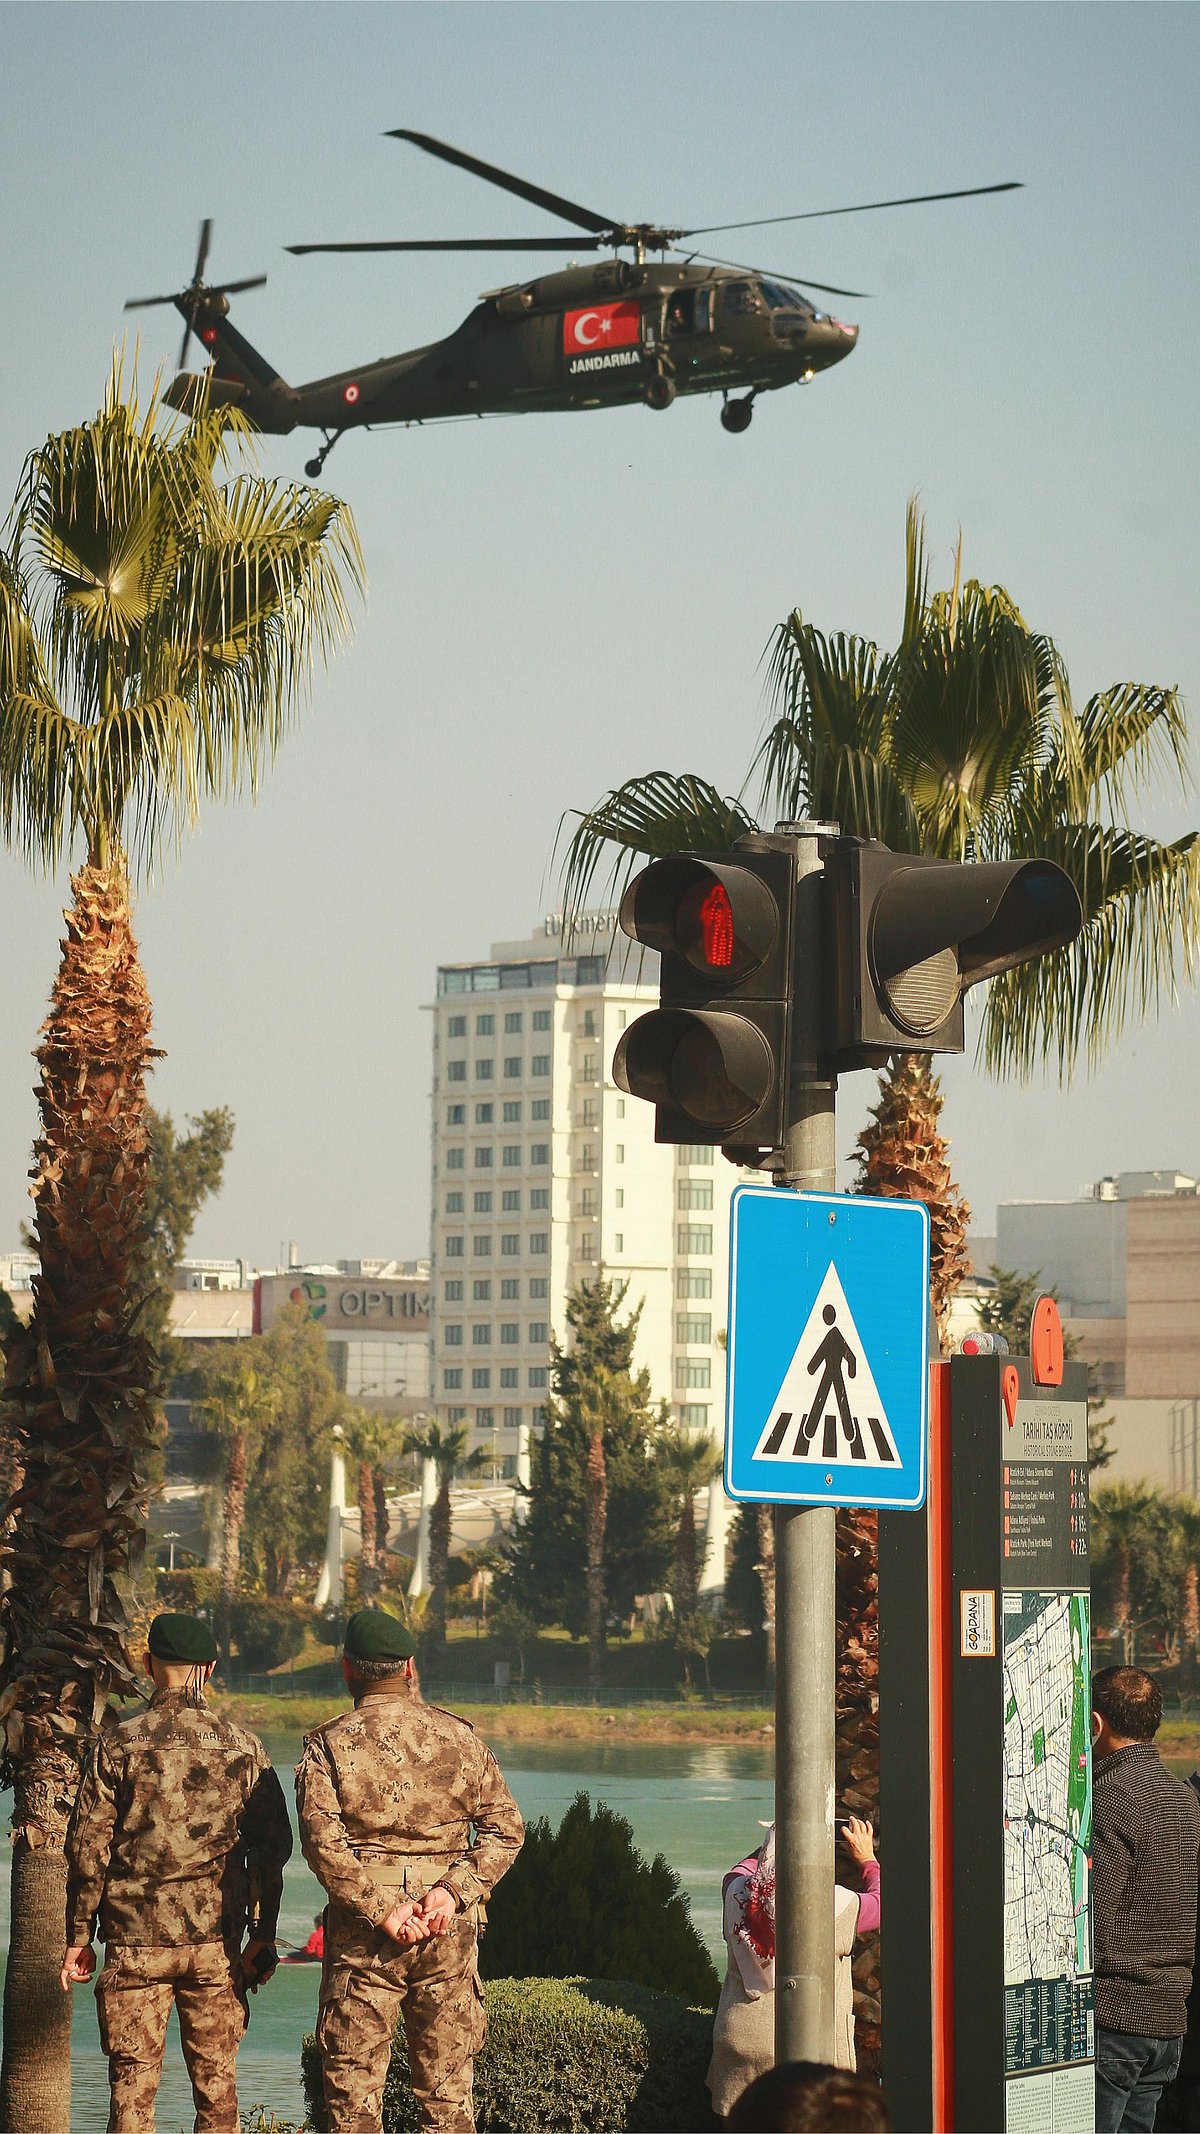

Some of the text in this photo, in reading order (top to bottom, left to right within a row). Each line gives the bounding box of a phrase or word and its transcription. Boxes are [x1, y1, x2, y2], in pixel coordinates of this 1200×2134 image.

[569, 350, 640, 374] JANDARMA
[1022, 1418, 1073, 1444] TARİHİ TAŞ KÖPRÜ
[1046, 1445, 1059, 1457] STONE
[968, 1596, 979, 1650] GOADANA
